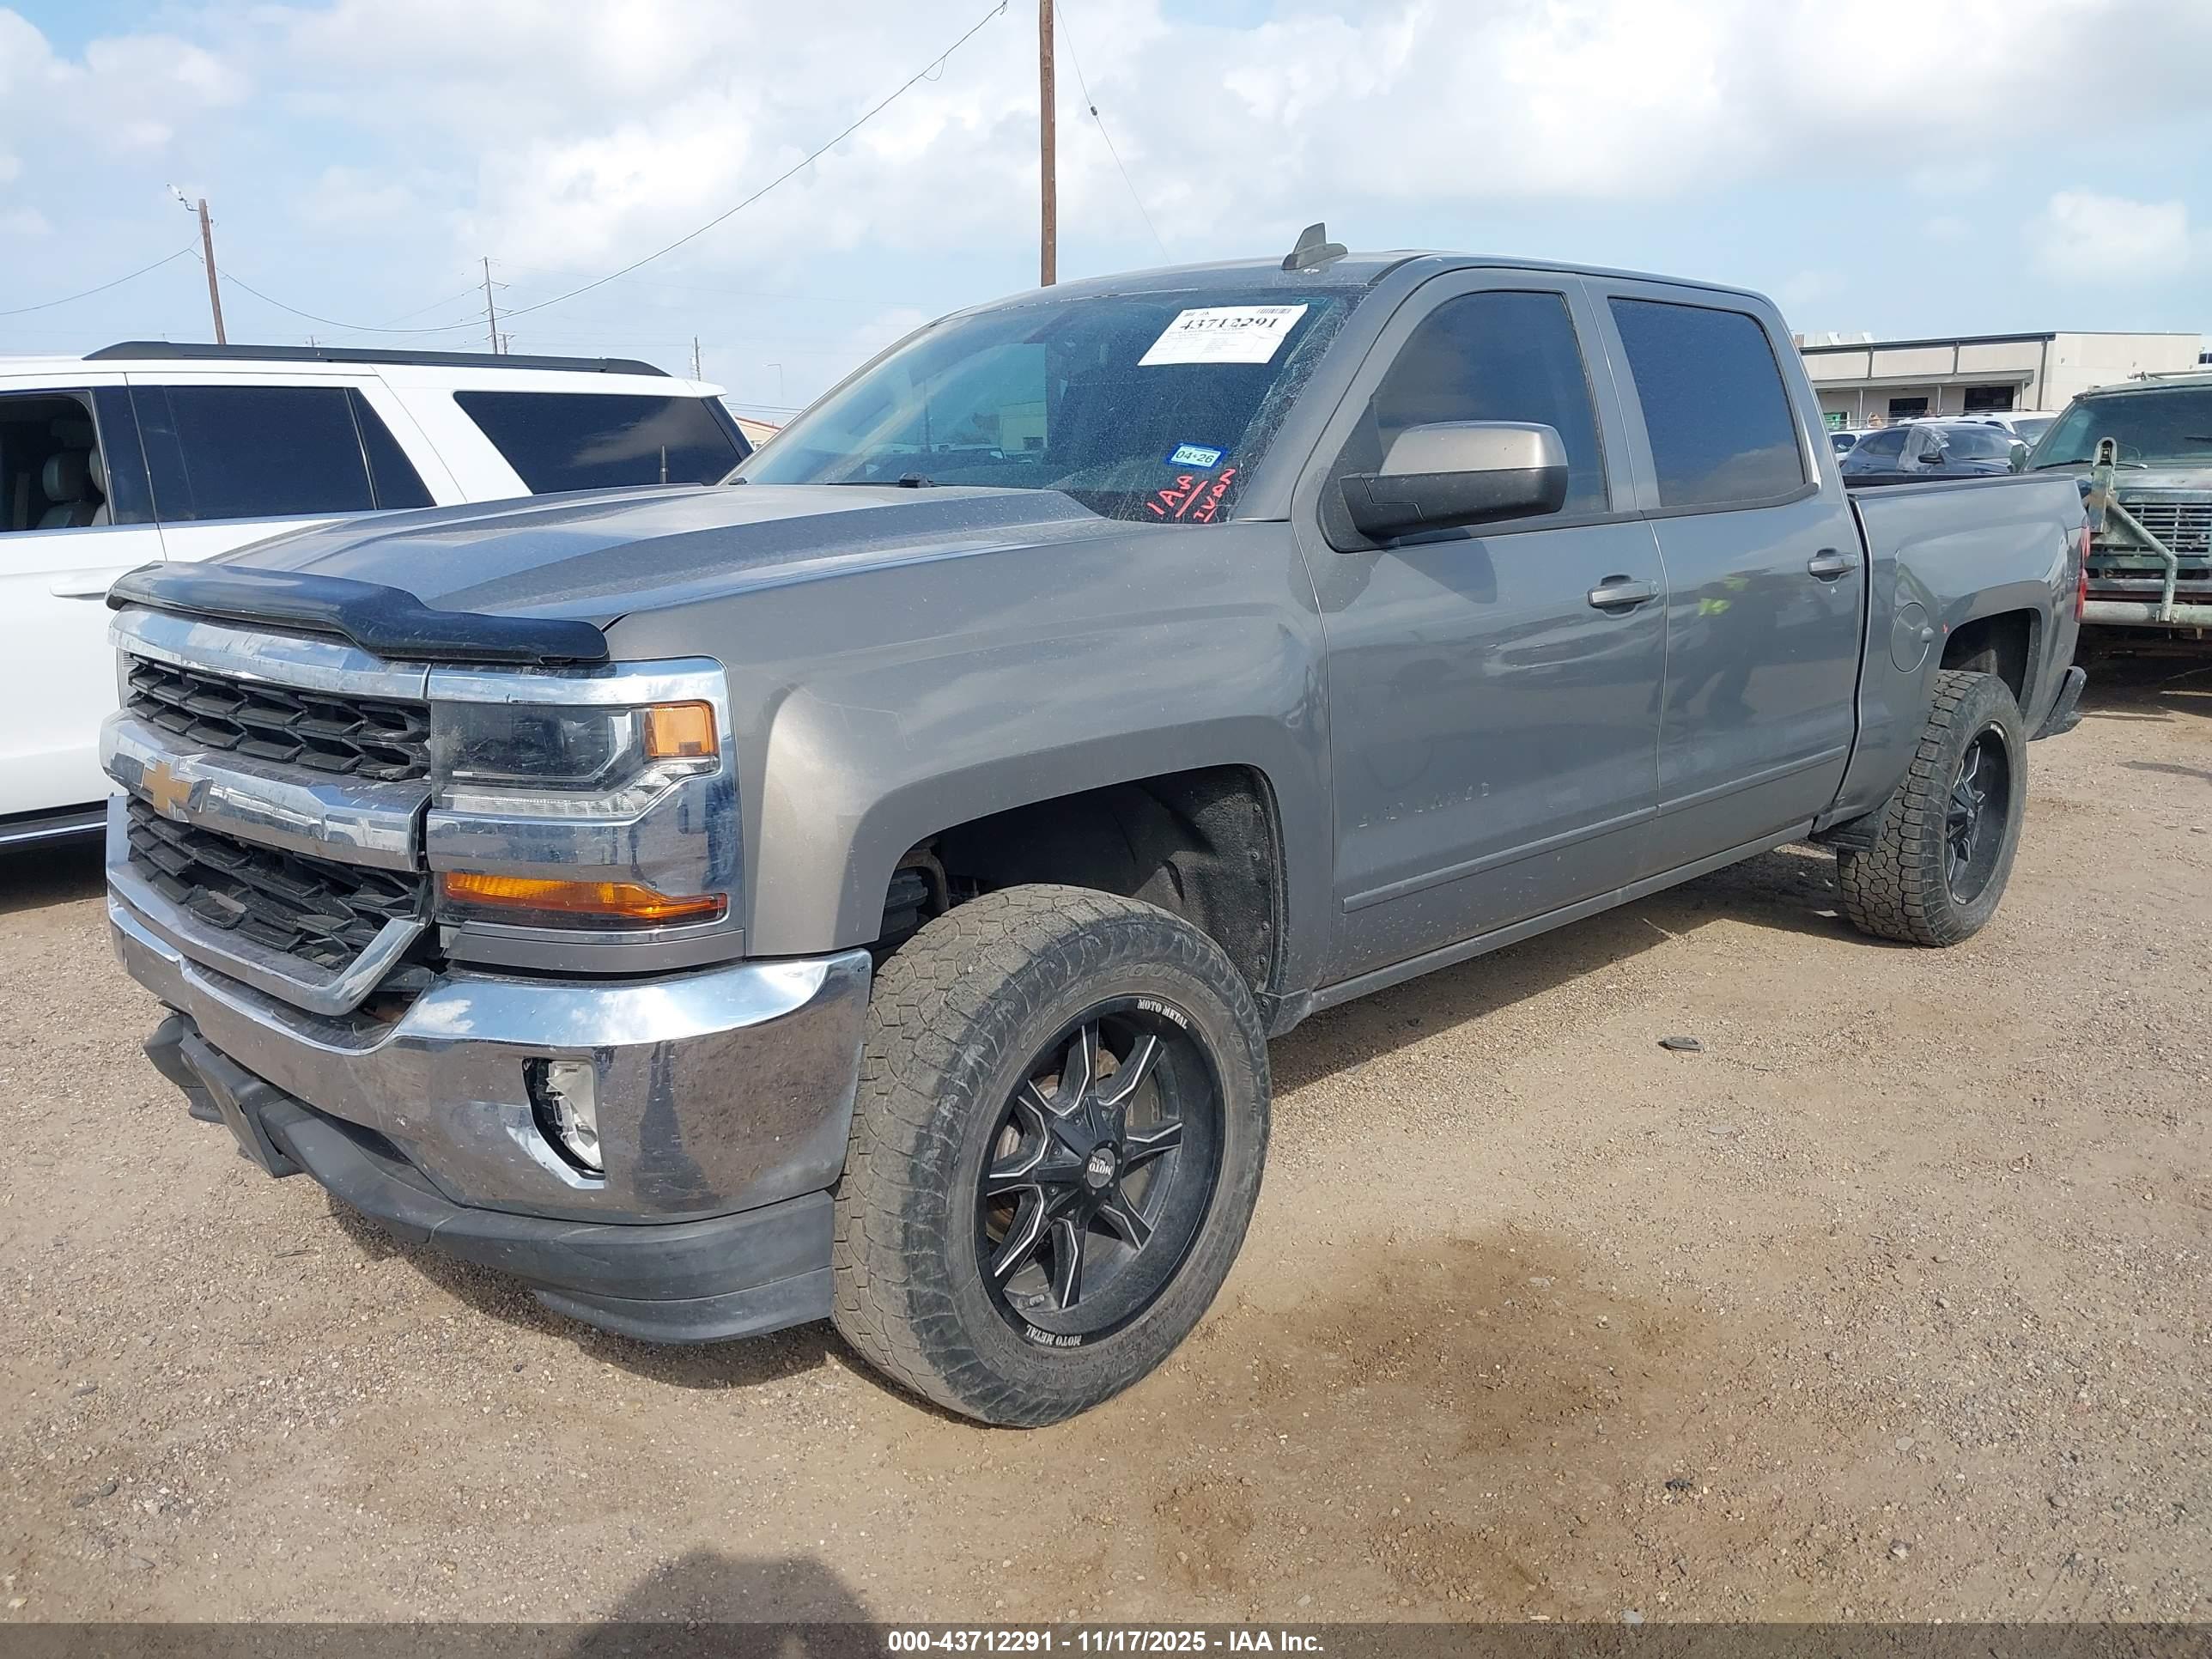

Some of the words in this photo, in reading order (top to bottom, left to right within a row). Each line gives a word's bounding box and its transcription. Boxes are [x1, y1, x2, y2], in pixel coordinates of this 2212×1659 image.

[1180, 318, 1279, 331] 43712291
[1137, 999, 1162, 1013] MOTO
[1162, 1005, 1189, 1030] METAL
[1089, 1161, 1114, 1175] MOTO
[1026, 1324, 1056, 1346] METAL
[1055, 1334, 1082, 1346] MOTO
